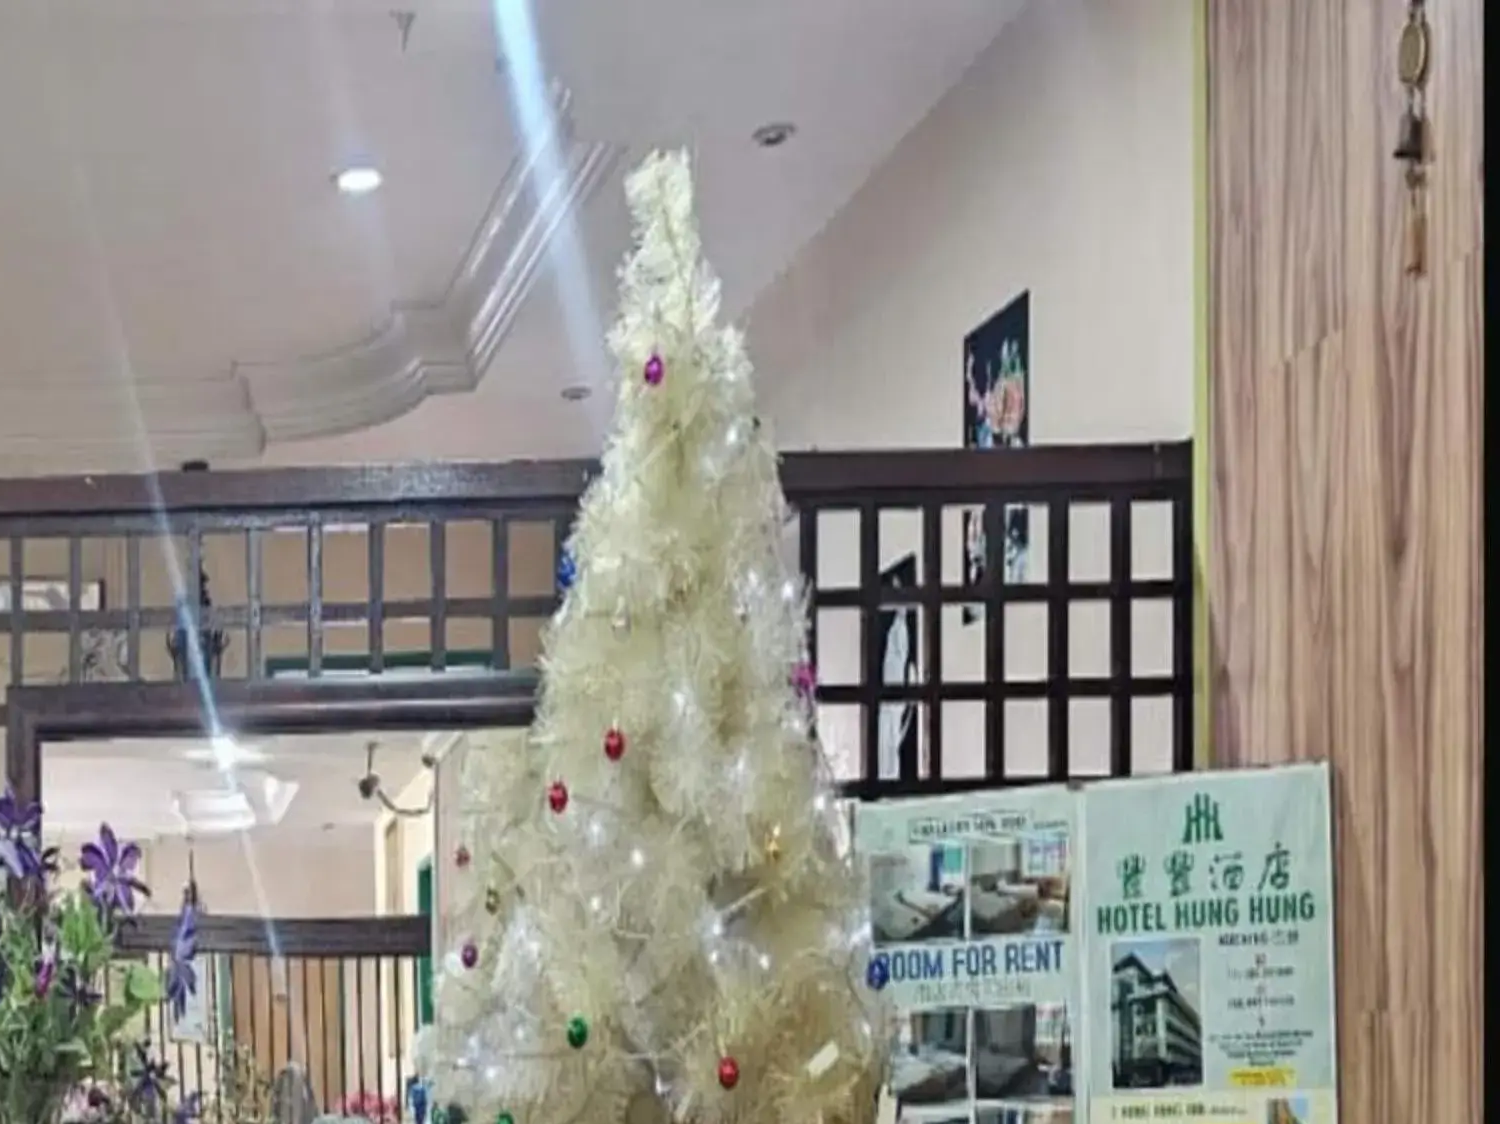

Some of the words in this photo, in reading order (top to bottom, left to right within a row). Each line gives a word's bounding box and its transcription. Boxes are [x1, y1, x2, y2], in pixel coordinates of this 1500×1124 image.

[1097, 901, 1167, 935] HOTEL
[1174, 897, 1240, 931] HUNG
[1249, 890, 1315, 925] HUNG
[952, 943, 997, 979] FOR
[1004, 939, 1065, 975] RENT
